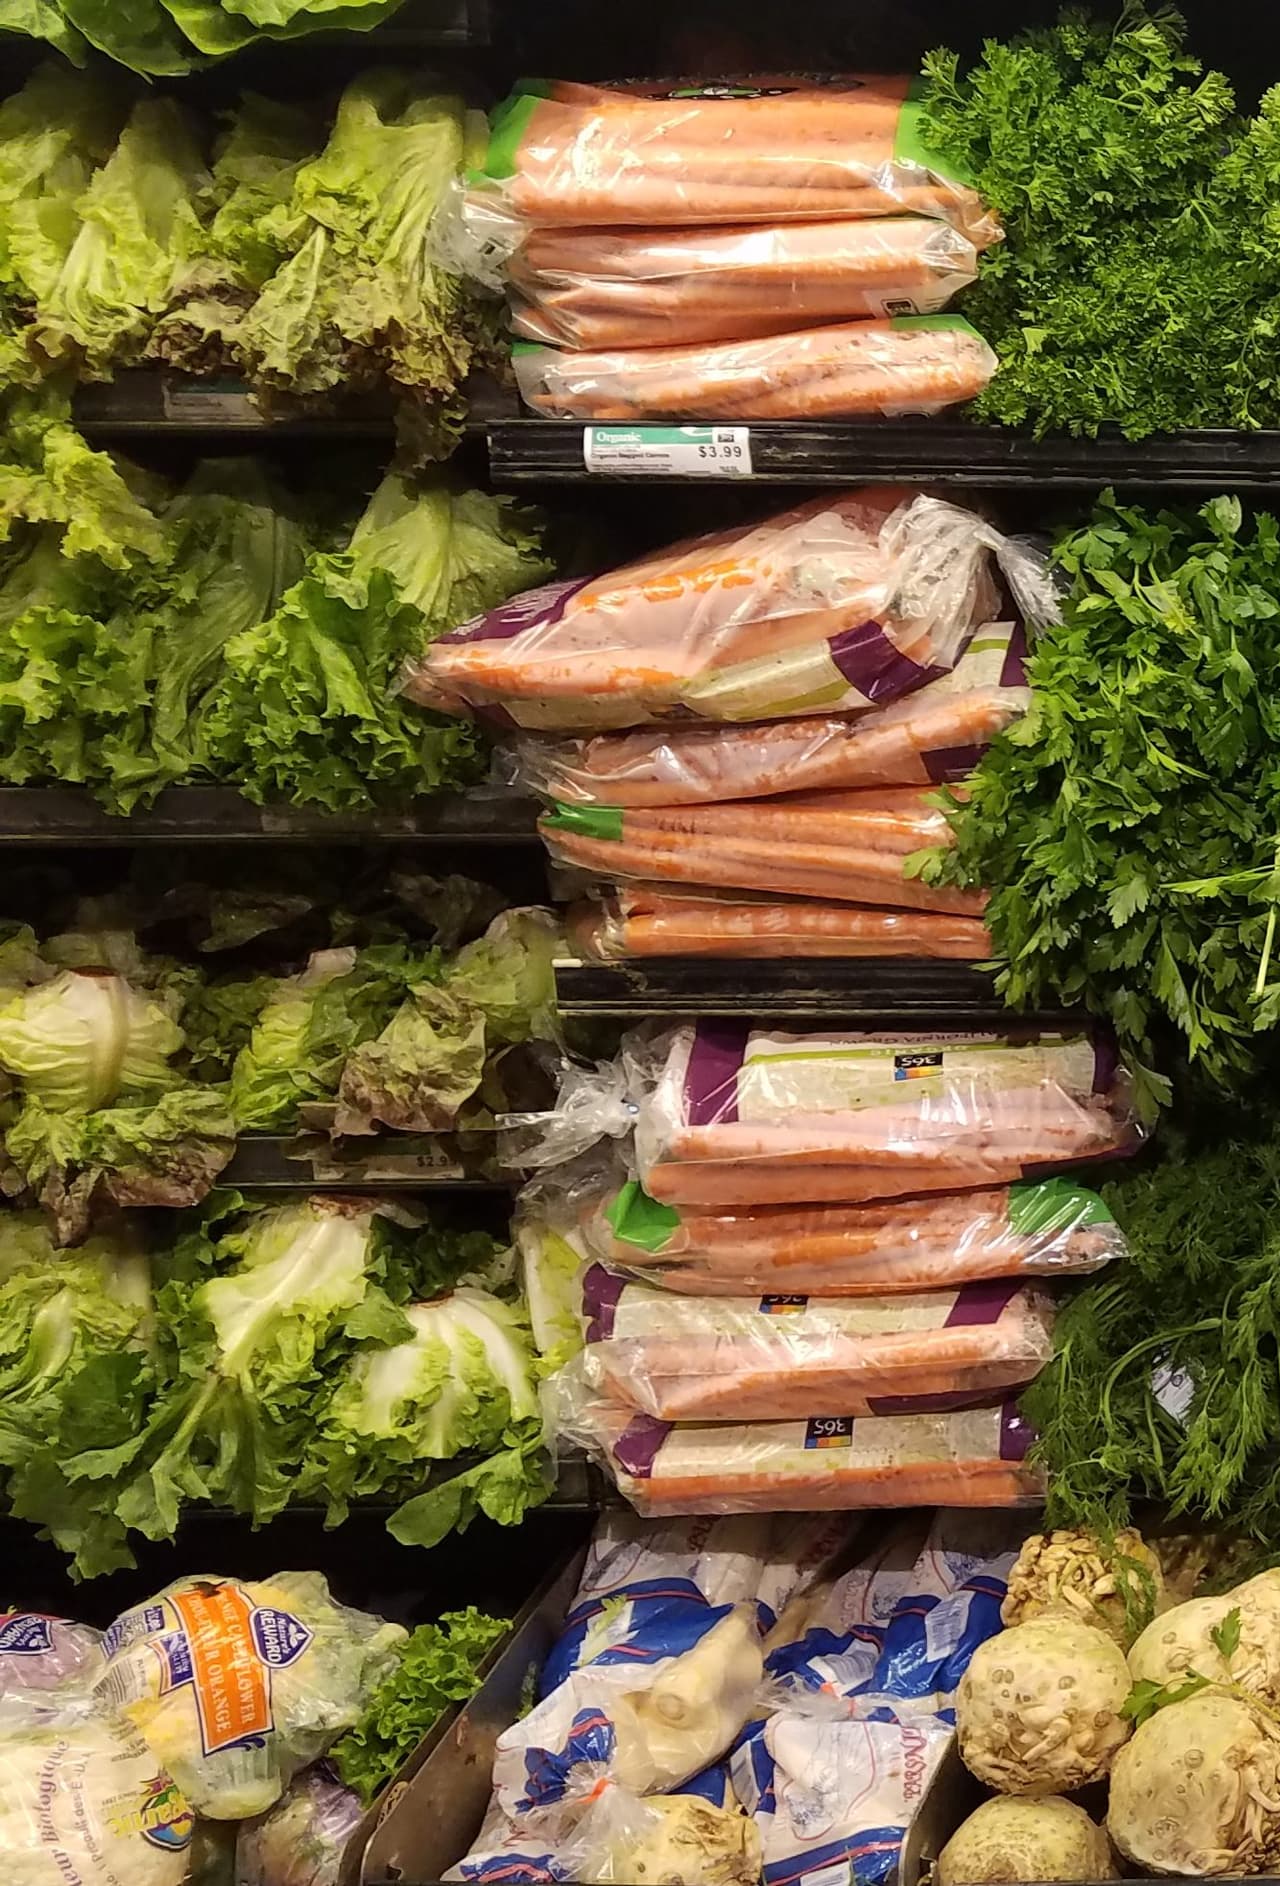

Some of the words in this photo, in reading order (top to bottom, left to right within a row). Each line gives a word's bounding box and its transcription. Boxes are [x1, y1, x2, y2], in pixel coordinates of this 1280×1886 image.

[596, 431, 642, 444] Organic
[698, 446, 742, 459] $3.99
[901, 1054, 937, 1067] 365
[813, 1419, 847, 1436] 365
[258, 1610, 283, 1663] REWARD
[276, 1616, 290, 1654] Nature's
[206, 1663, 231, 1733] ORANGE
[32, 1740, 70, 1843] Biologique
